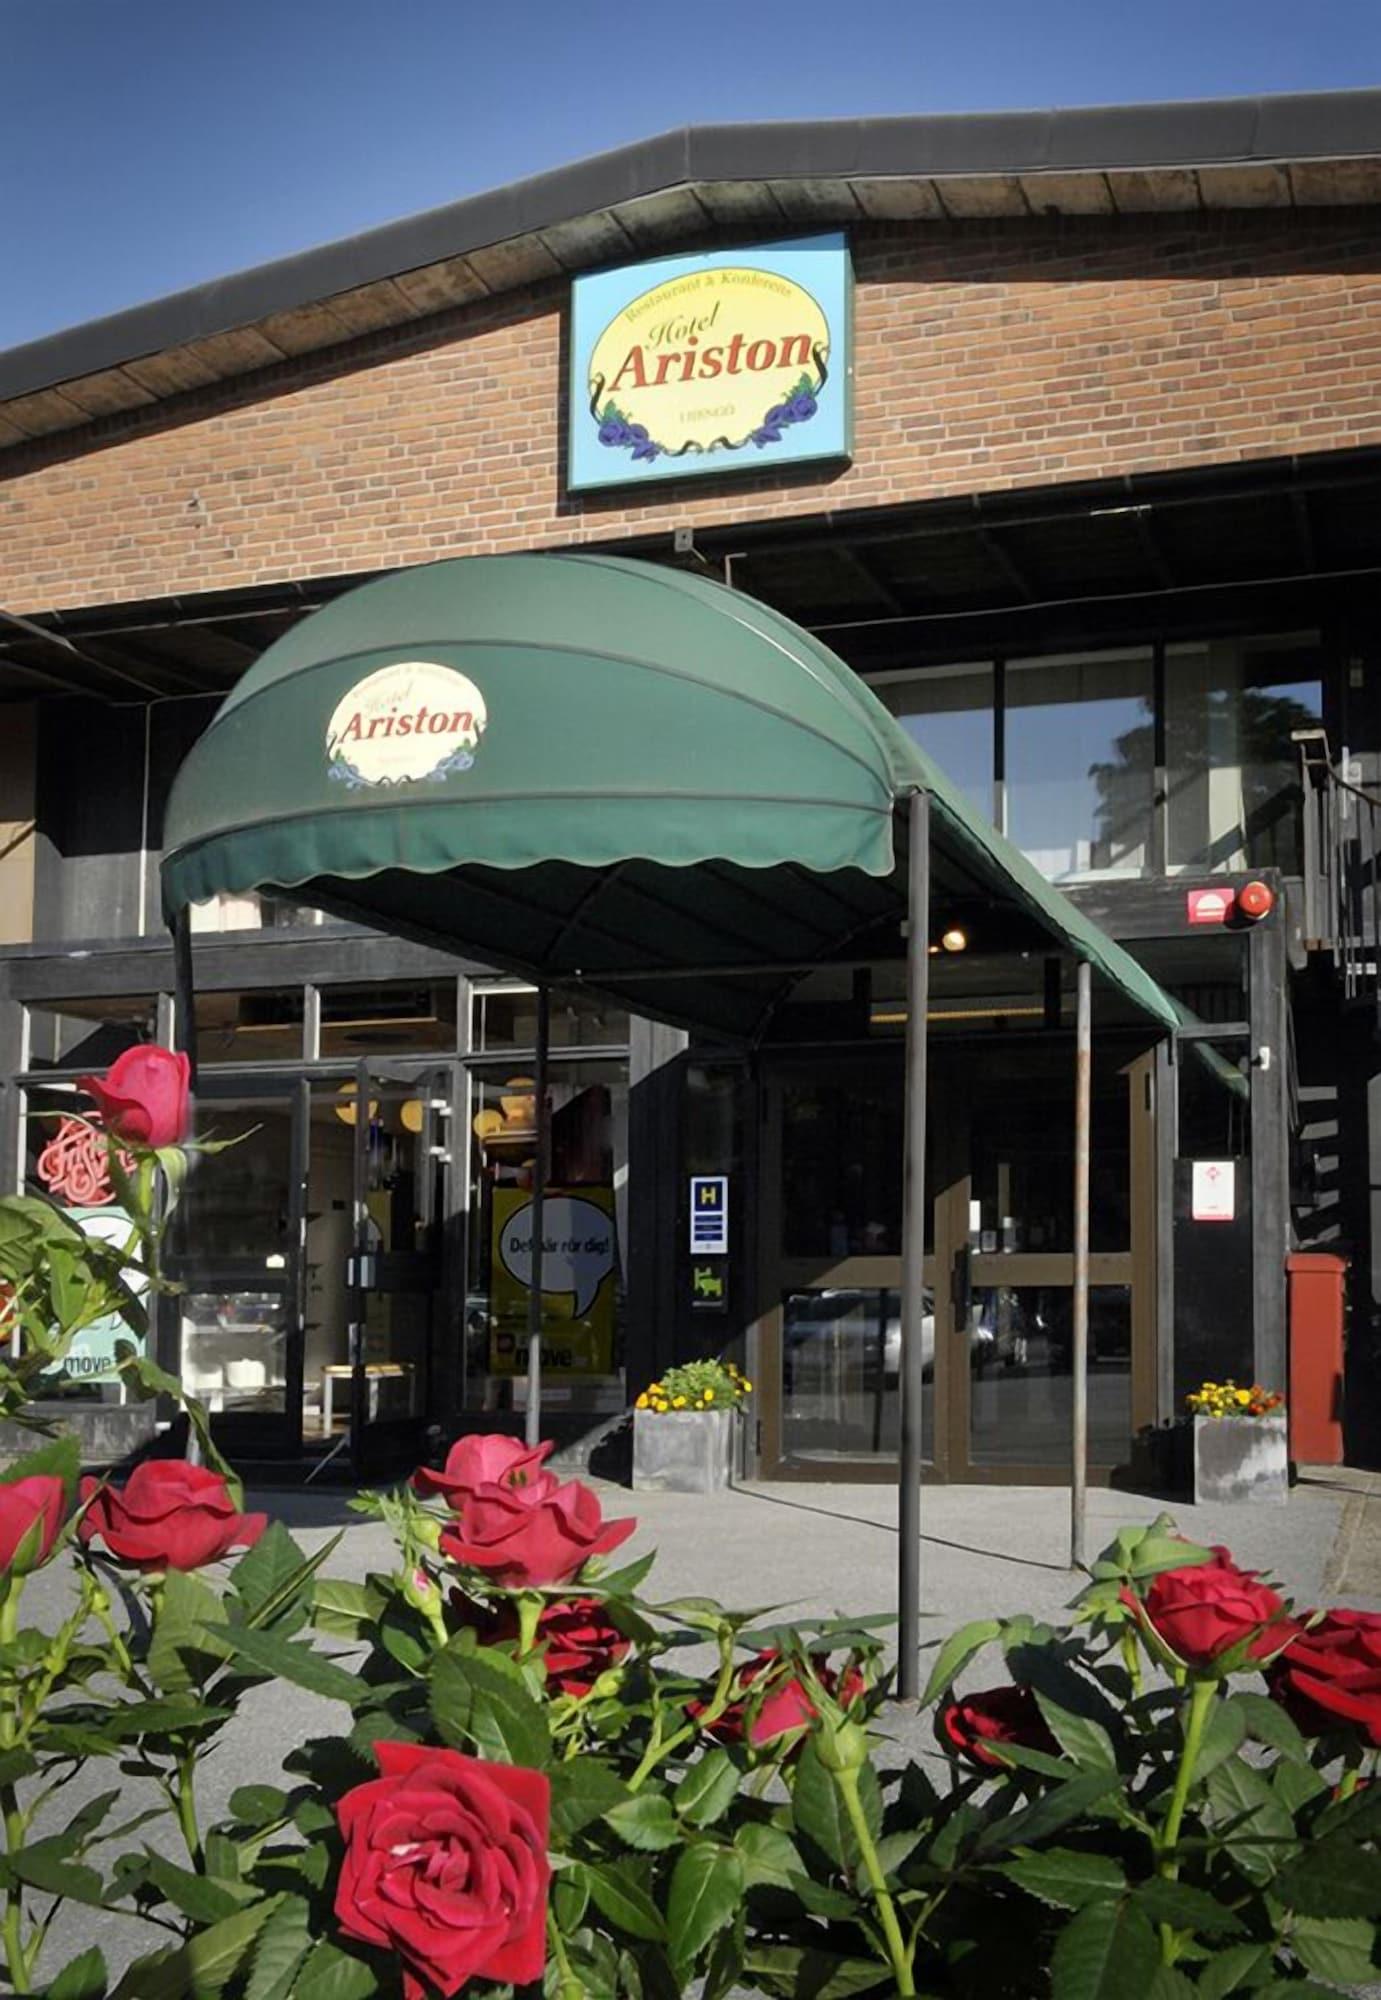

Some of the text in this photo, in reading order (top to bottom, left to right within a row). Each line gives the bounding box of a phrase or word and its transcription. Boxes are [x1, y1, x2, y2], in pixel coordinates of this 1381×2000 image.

[624, 276, 700, 323] Restaurant
[646, 299, 720, 349] Hotel
[606, 332, 813, 392] Ariston
[337, 705, 473, 744] Ariston
[701, 1186, 716, 1205] H
